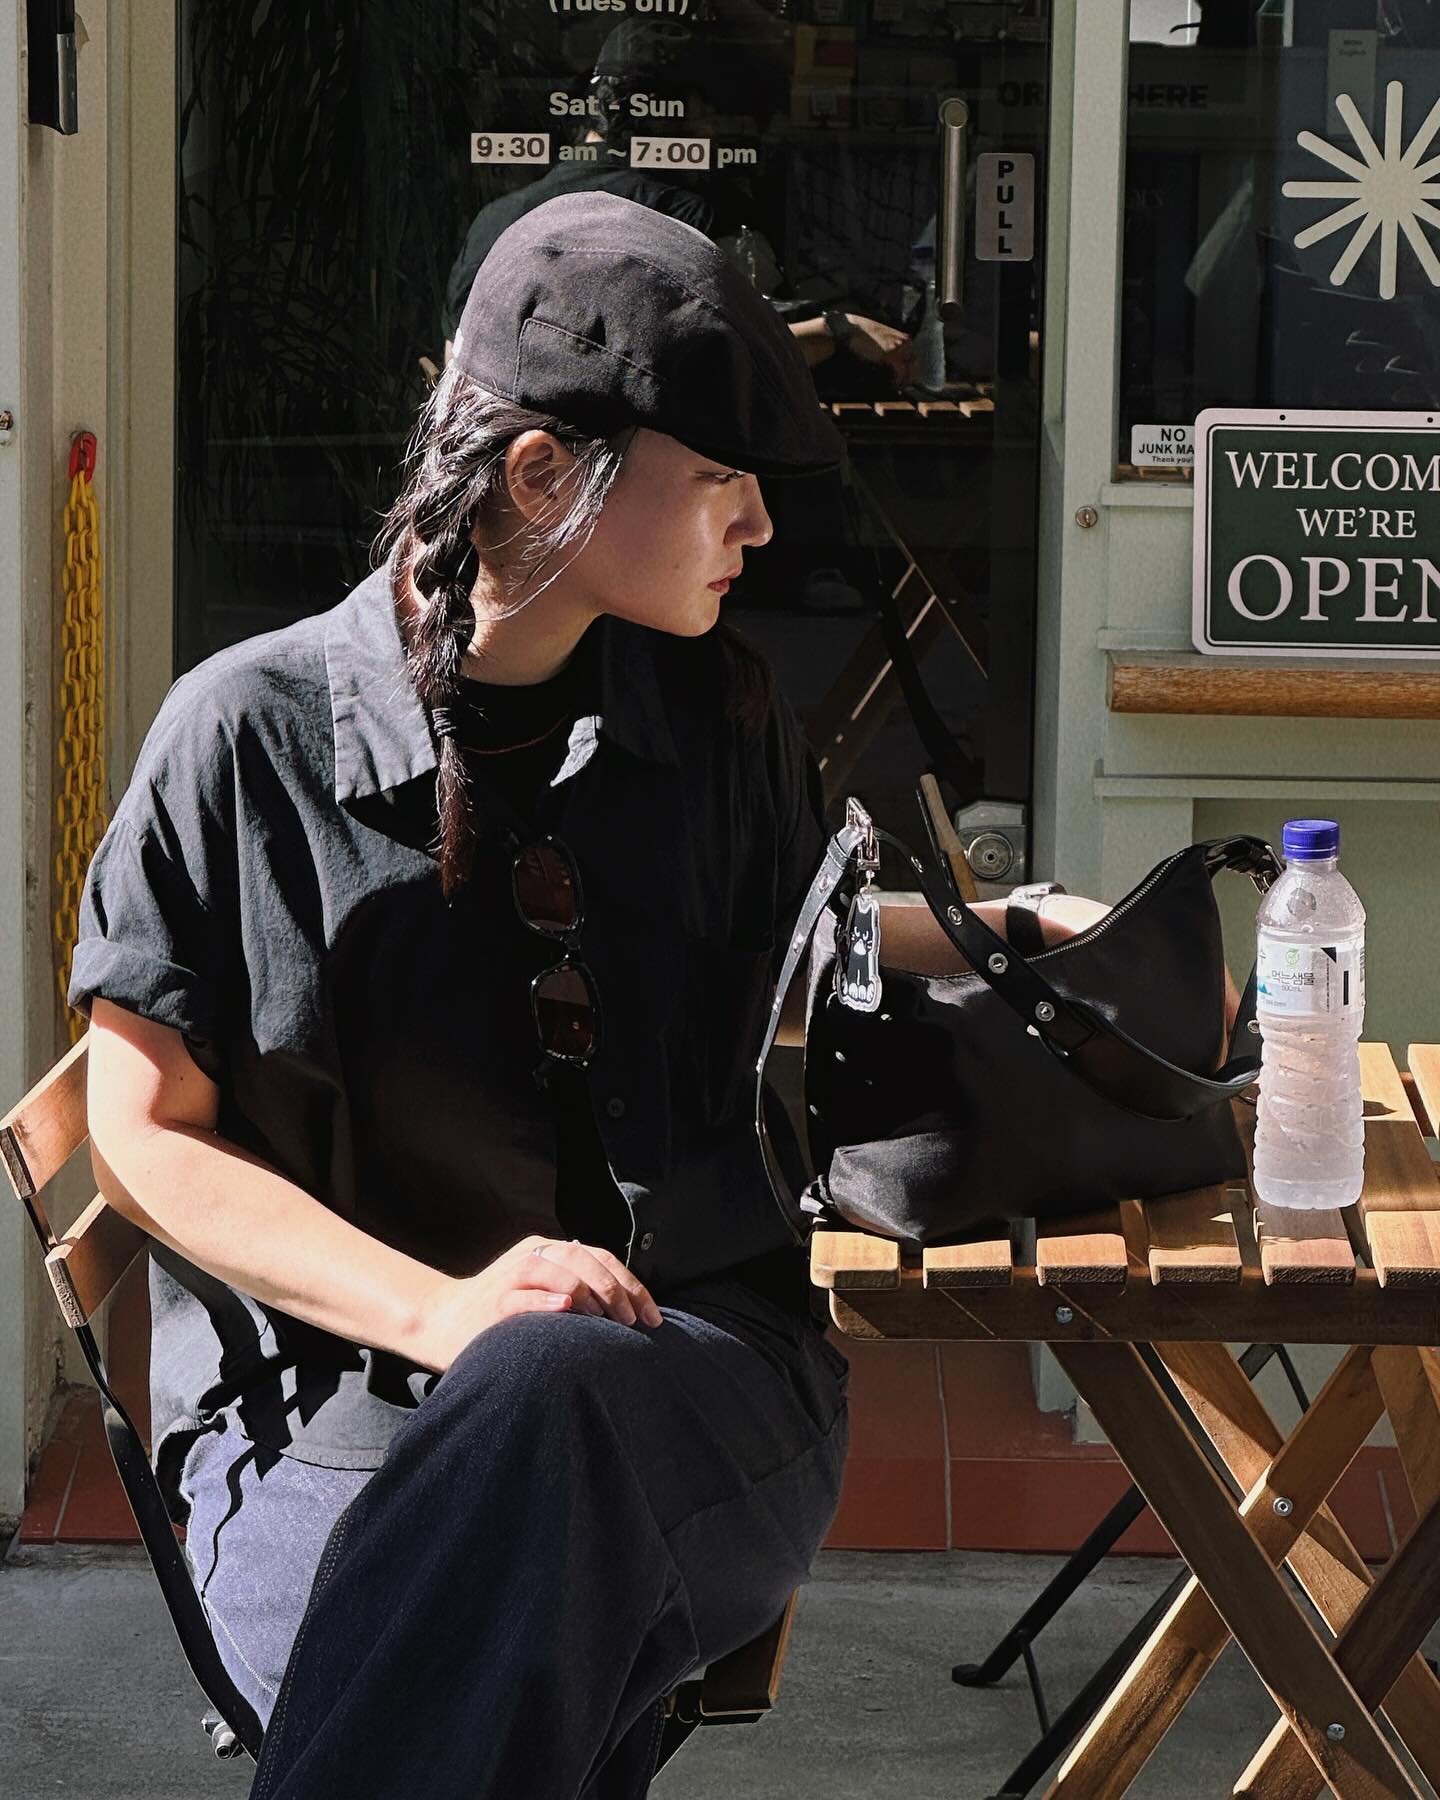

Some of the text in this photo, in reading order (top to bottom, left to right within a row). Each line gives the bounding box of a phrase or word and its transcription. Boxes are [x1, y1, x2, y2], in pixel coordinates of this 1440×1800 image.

[549, 91, 600, 116] Sat
[629, 92, 685, 118] Sun
[476, 136, 545, 158] 9:30
[558, 145, 597, 161] am
[636, 142, 705, 164] 7:00
[717, 148, 757, 169] pm
[997, 160, 1015, 254] PULL
[1139, 443, 1172, 454] JUNK
[1160, 428, 1186, 442] NO
[1225, 451, 1440, 491] WELCOM
[1296, 507, 1417, 538] WE’RE
[1228, 554, 1440, 623] OPEN
[1271, 970, 1316, 986] 먹는샘물
